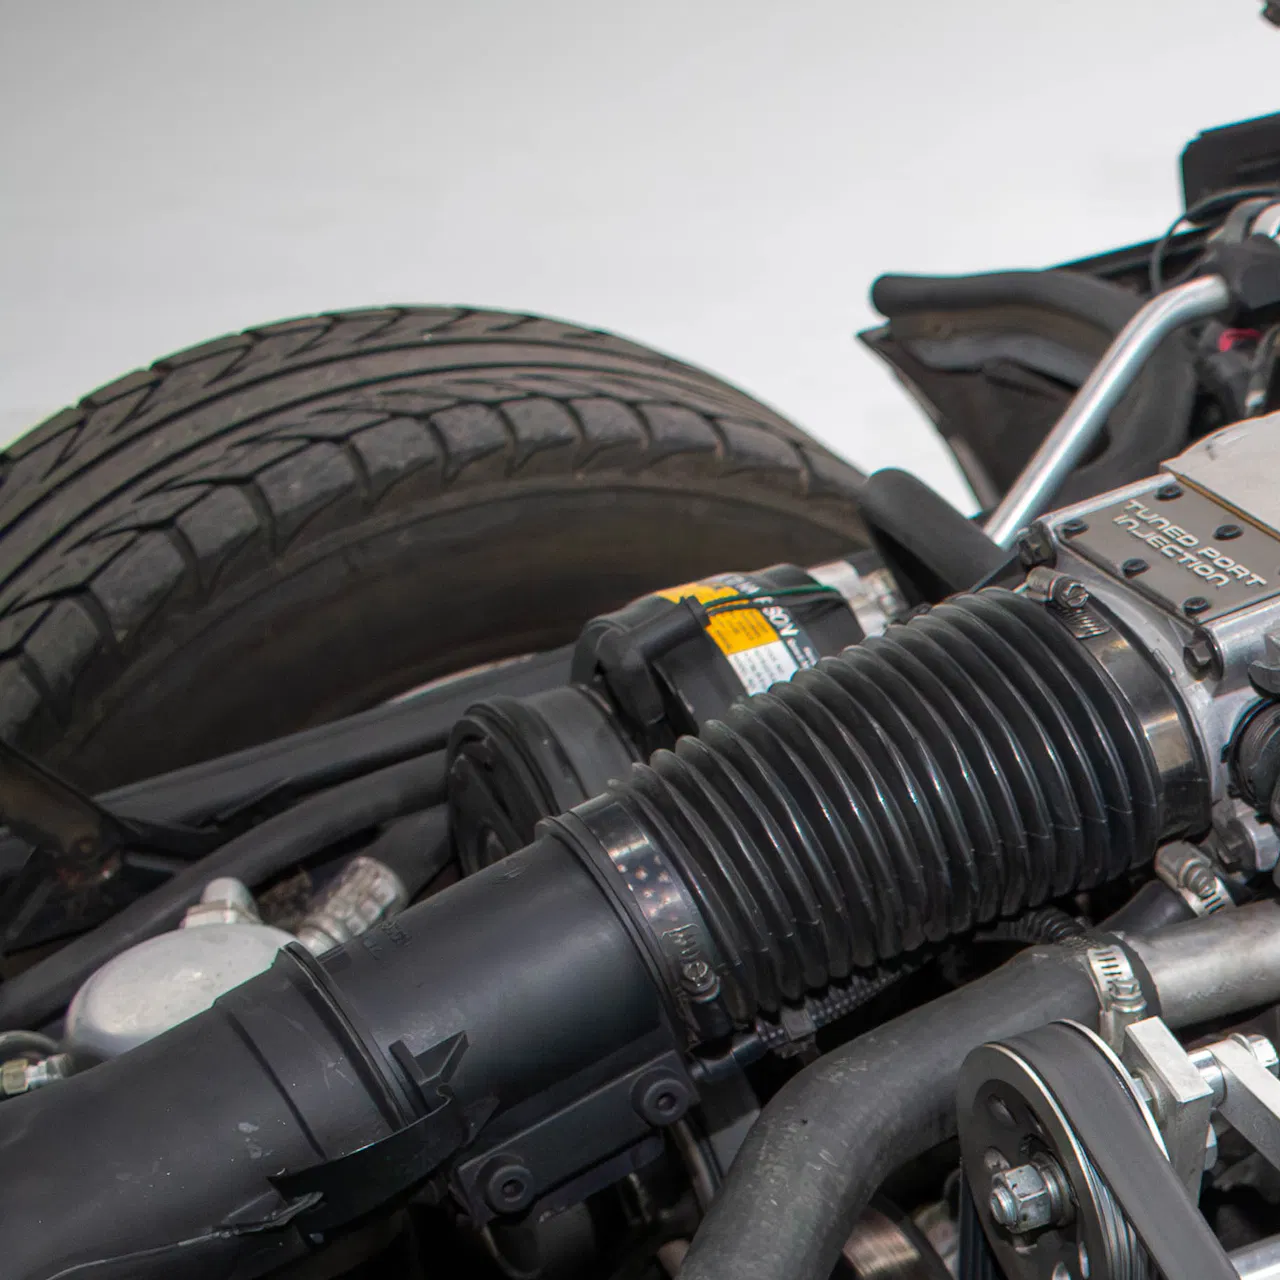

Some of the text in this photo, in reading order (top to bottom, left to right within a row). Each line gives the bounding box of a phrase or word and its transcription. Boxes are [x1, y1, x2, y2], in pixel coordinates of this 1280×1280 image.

[1112, 513, 1230, 586] INJECTION
[1125, 501, 1267, 588] TUNED PORT
